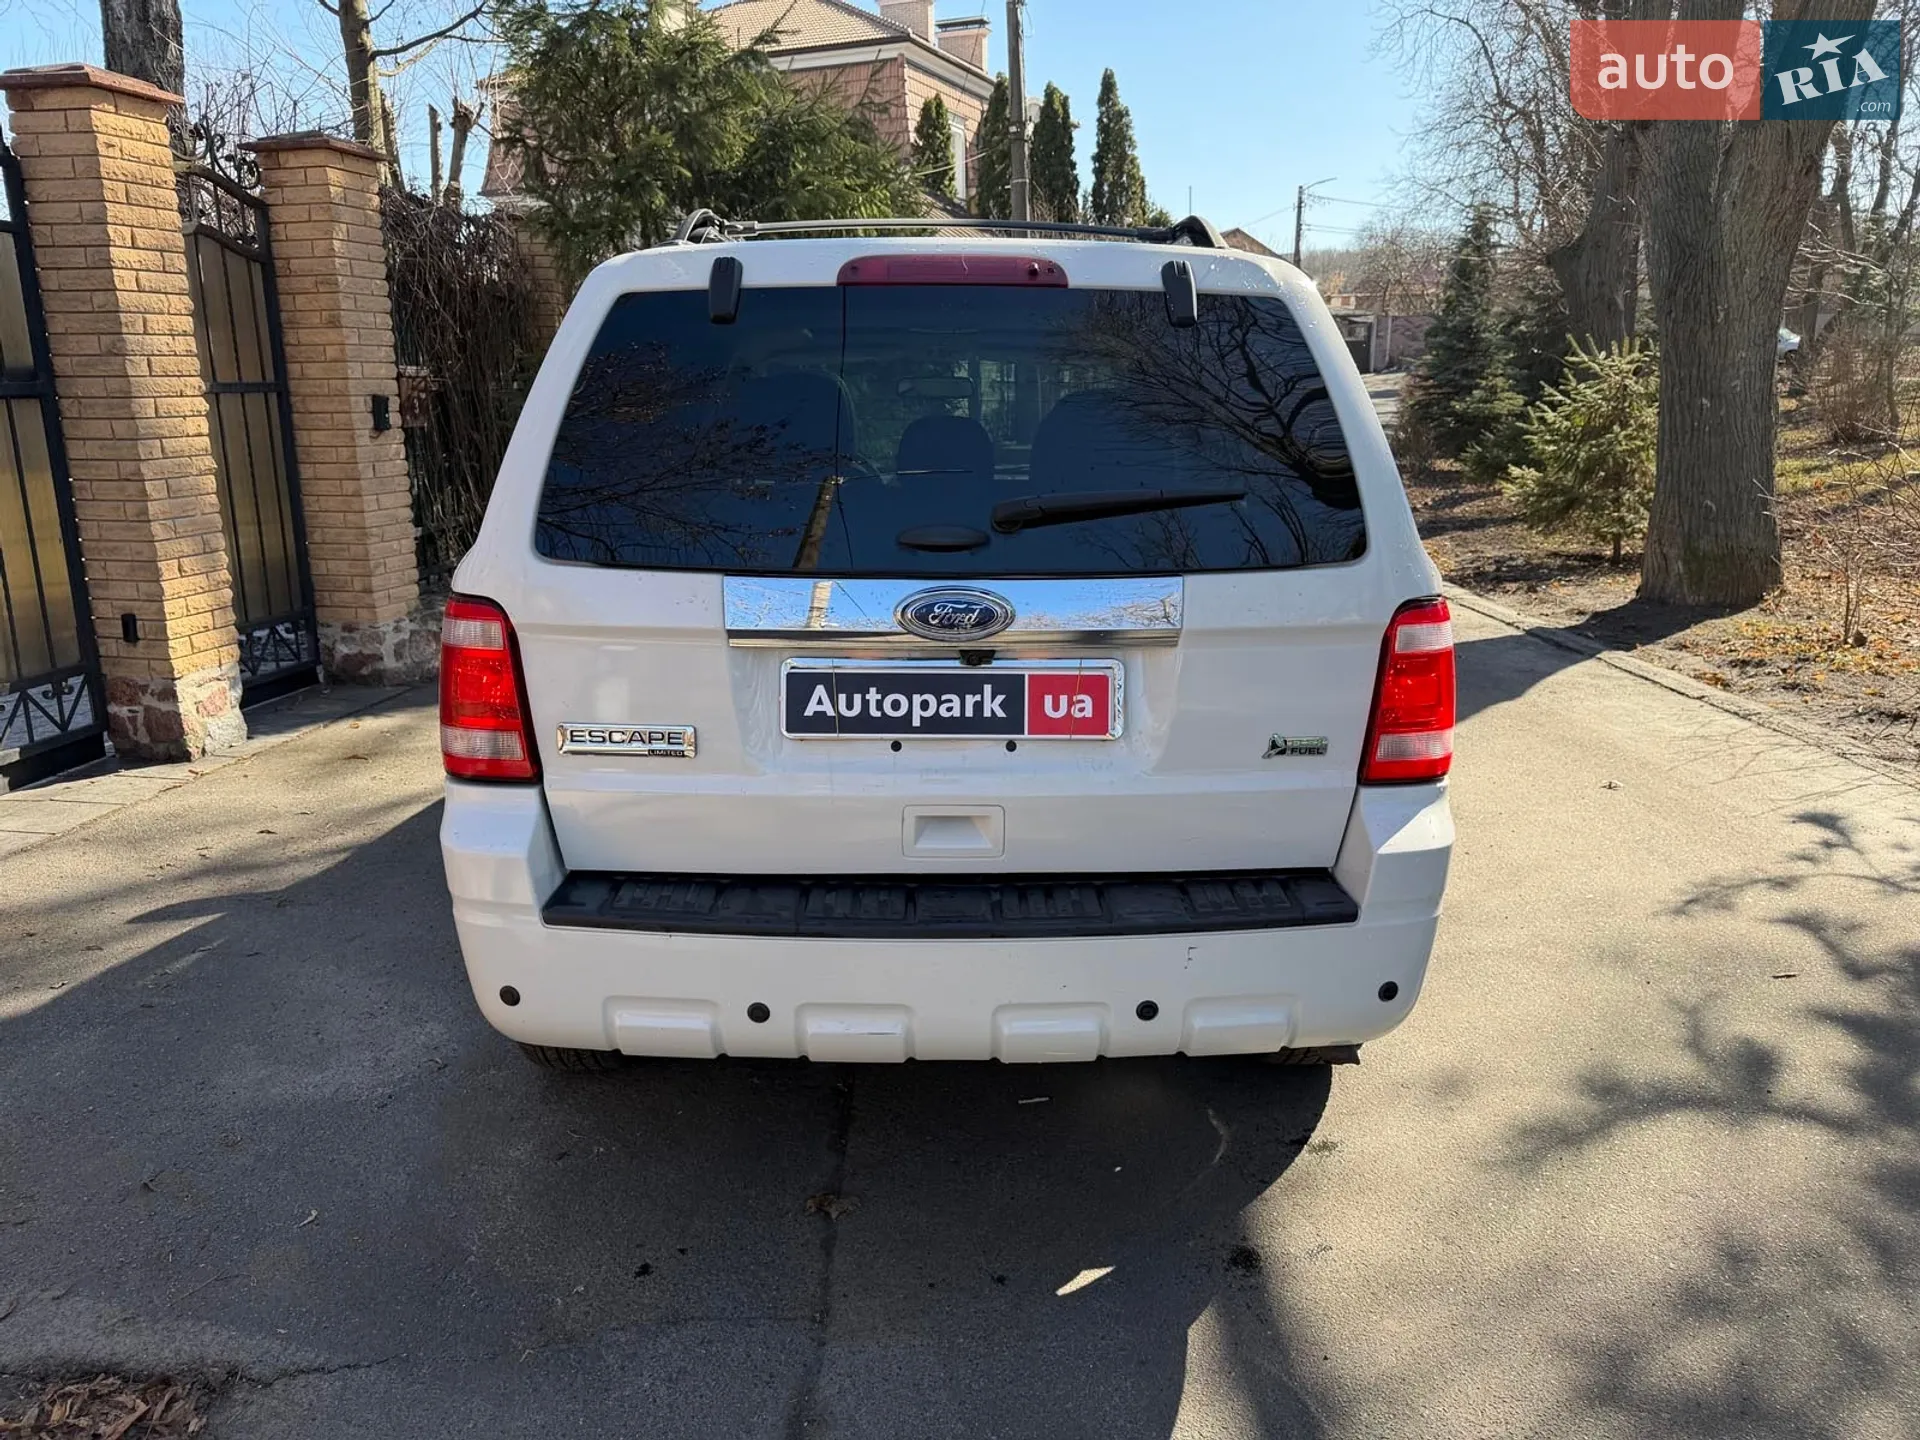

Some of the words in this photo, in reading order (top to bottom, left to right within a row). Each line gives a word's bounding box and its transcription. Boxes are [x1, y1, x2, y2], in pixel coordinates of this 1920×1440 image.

[929, 602, 983, 626] Ford
[804, 684, 1007, 727] Autopark
[1043, 694, 1093, 718] ua
[570, 730, 683, 745] ESCAPE
[1290, 747, 1324, 755] FUEL
